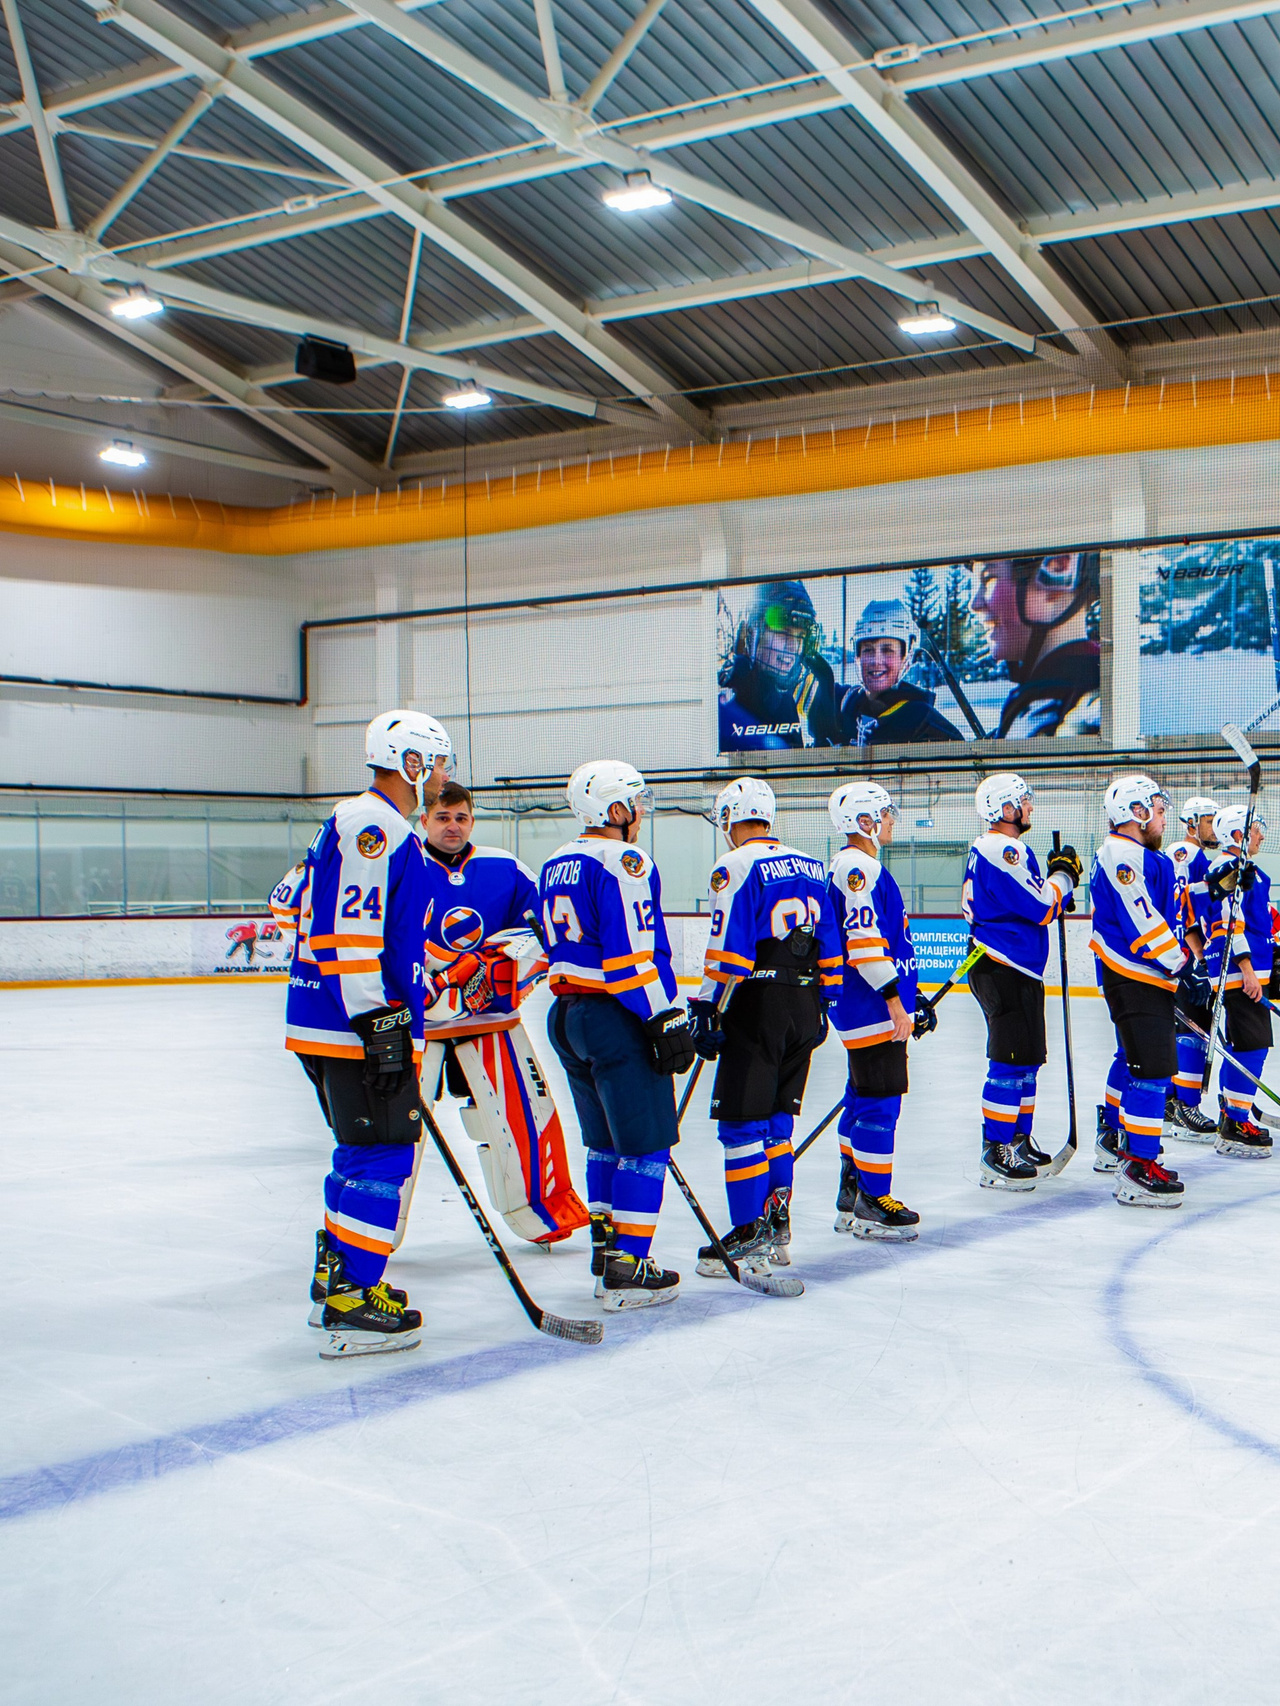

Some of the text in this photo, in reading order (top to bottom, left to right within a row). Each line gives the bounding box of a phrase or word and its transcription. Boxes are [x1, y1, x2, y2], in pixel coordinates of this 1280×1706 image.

[743, 721, 801, 737] BAUER
[341, 885, 382, 920] 24
[1133, 896, 1153, 920] 7
[632, 899, 655, 932] 12
[844, 905, 874, 930] 20
[913, 945, 968, 958] СНАЩЕНИЕ
[213, 965, 291, 974] МАГАЗИН ХОКК
[915, 957, 954, 971] ЕДОВЫХ
[372, 1007, 412, 1033] CC
